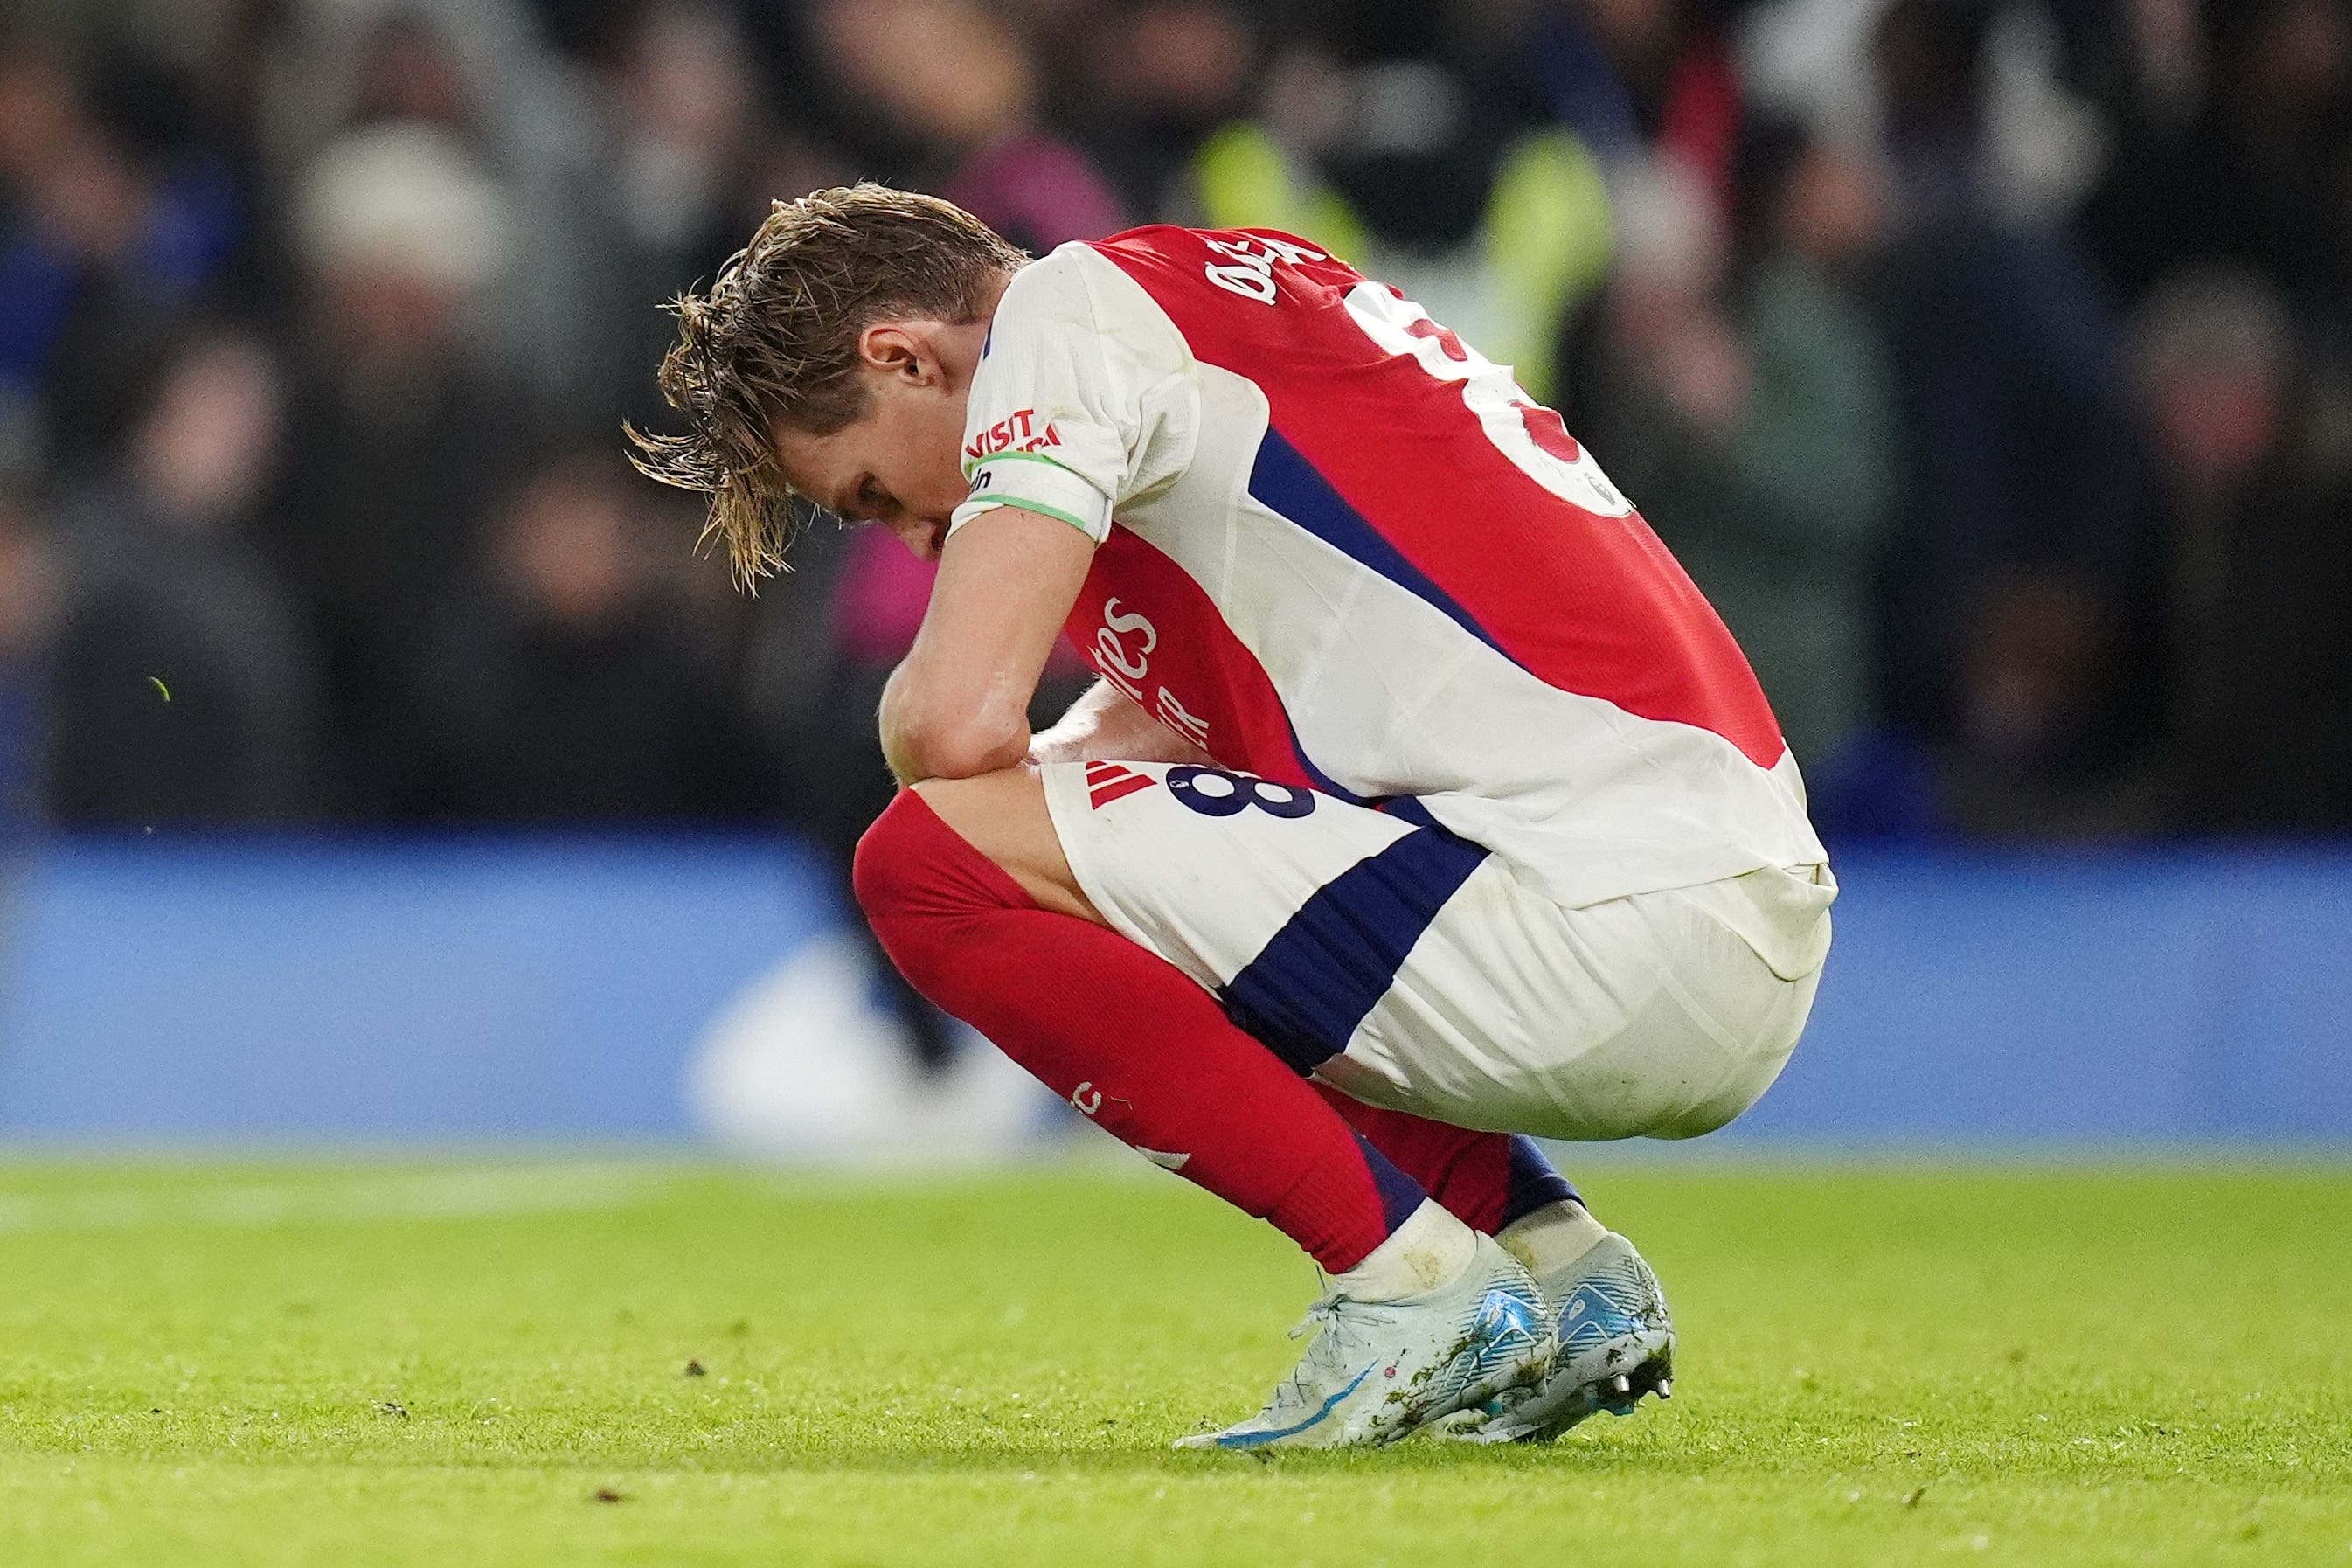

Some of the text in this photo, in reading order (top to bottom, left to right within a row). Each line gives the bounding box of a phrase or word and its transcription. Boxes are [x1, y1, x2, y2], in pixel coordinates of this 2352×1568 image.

[1343, 281, 1638, 519] 8
[965, 408, 1035, 459] VISIT
[1086, 596, 1158, 710] tes
[1165, 766, 1316, 819] 8
[1070, 1081, 1102, 1114] C
